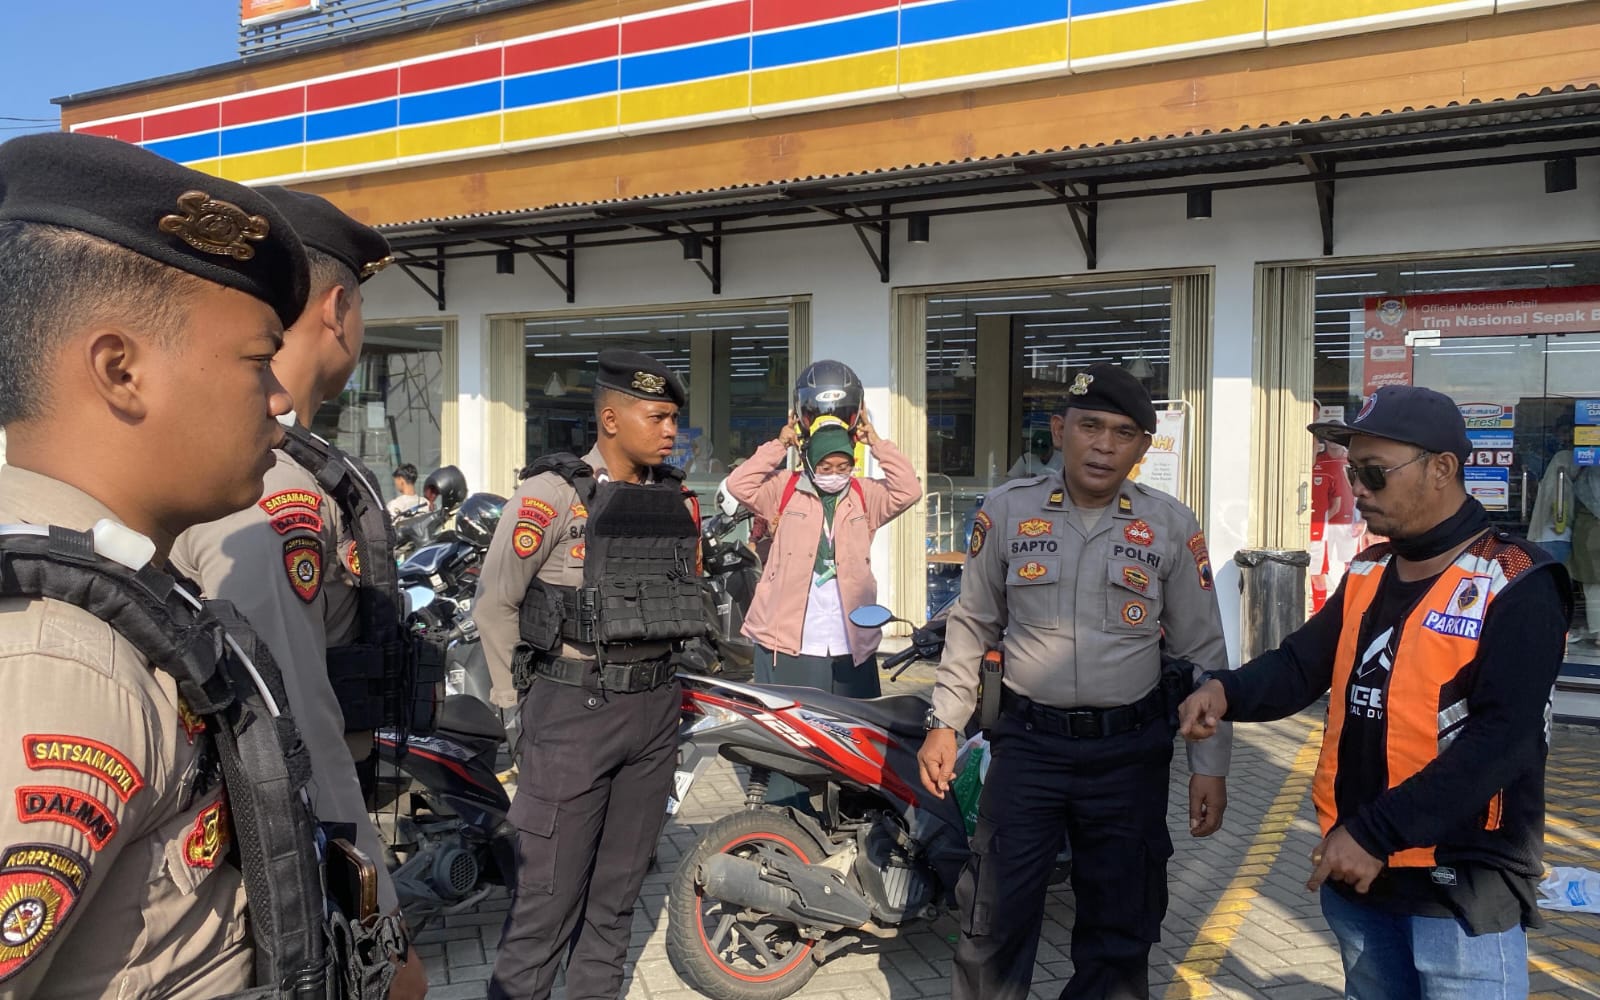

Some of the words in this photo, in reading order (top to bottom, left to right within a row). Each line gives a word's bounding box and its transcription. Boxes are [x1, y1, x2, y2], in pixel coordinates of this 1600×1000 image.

[1421, 303, 1457, 313] Official
[1461, 301, 1503, 312] Modern
[1506, 300, 1537, 309] Retail
[1421, 316, 1450, 328] Tim
[1456, 312, 1527, 327] Nasional
[1532, 310, 1585, 326] Sepak
[1467, 417, 1502, 427] Fresh
[265, 493, 316, 510] SATSAMAPTA
[1011, 540, 1058, 554] SAPTO
[1113, 544, 1161, 569] POLRI
[1425, 611, 1478, 638] PARKIR
[35, 742, 134, 792] SATSAMAPTA
[26, 793, 113, 841] DALMAS
[5, 850, 50, 867] KORPS
